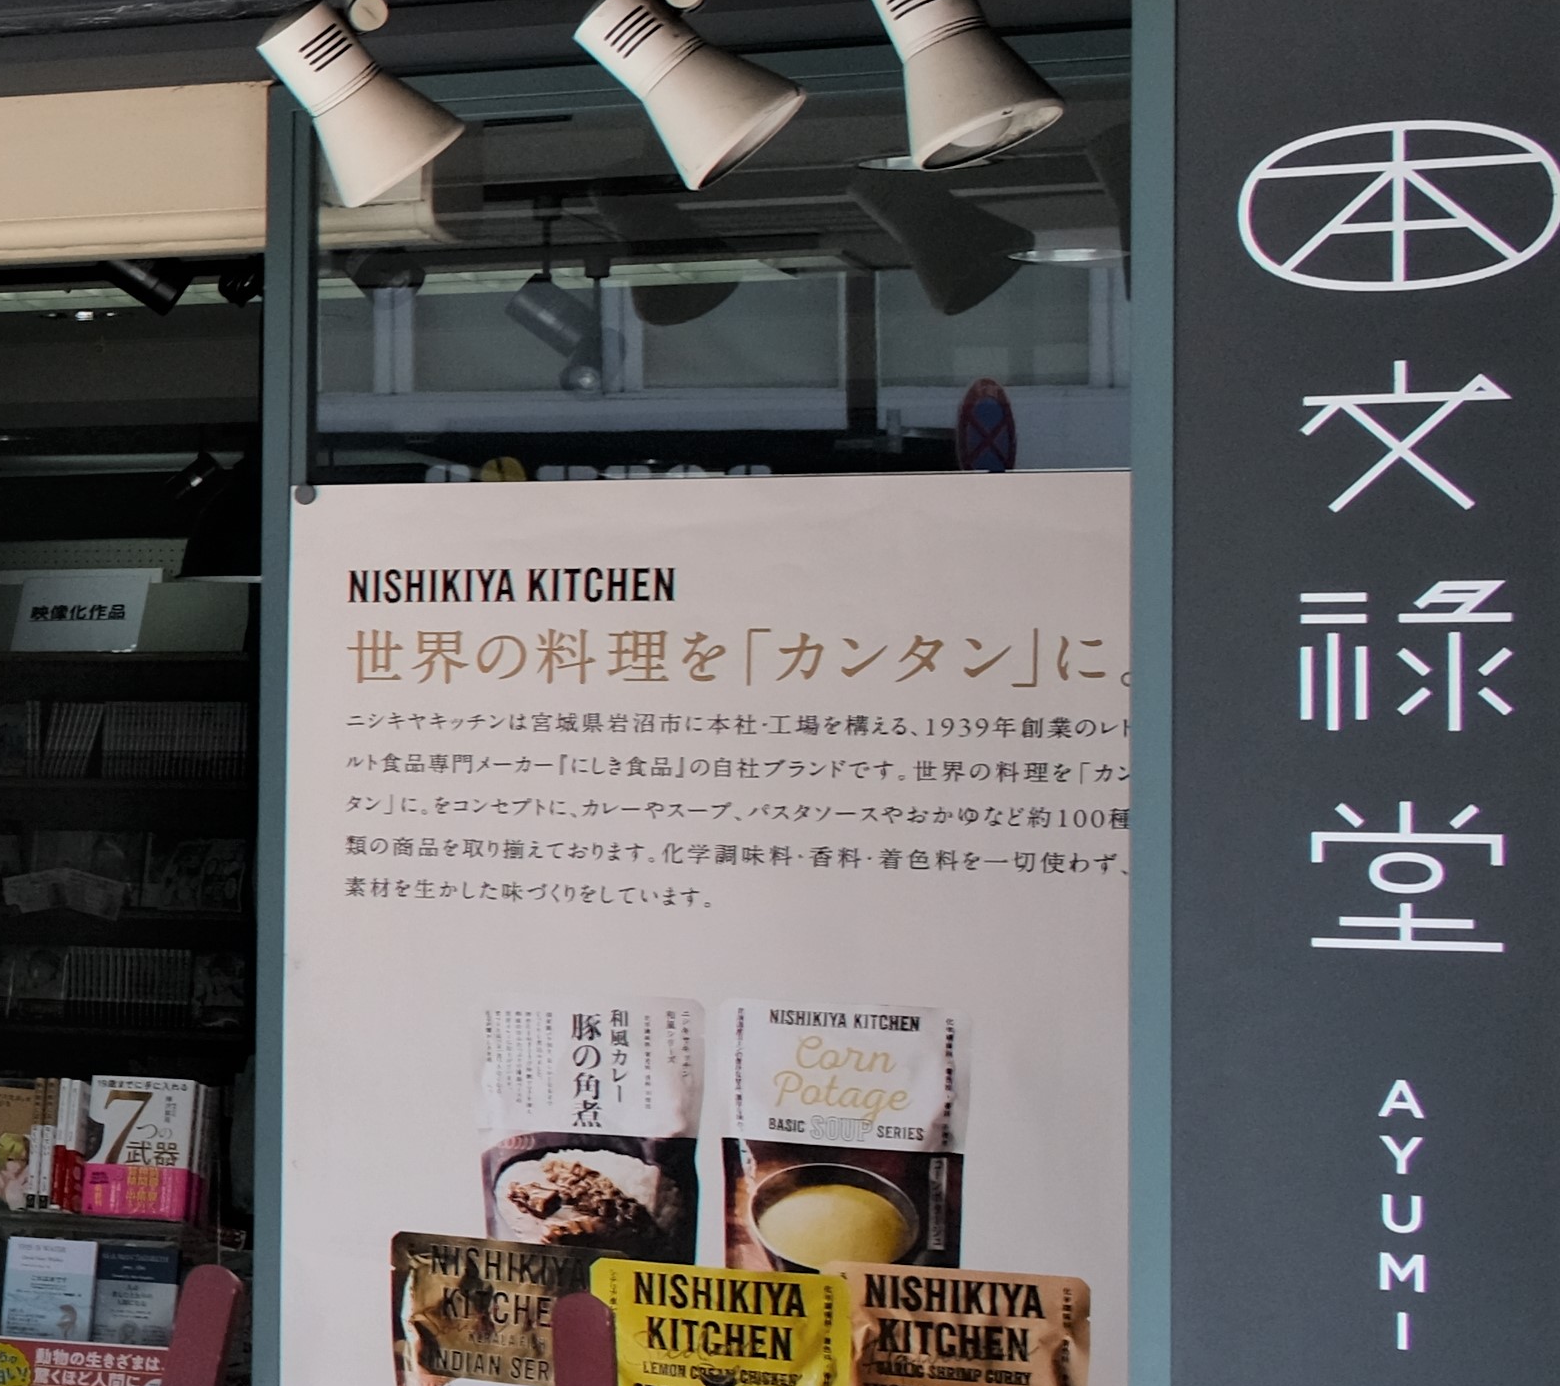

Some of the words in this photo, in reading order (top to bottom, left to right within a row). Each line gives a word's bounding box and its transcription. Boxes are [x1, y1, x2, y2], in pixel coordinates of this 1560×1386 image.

[347, 568, 515, 604] NISHIKIYA
[528, 566, 676, 603] KITCHEN
[30, 604, 126, 623] 映像化作品
[1301, 360, 1513, 952] 文禄堂
[345, 877, 712, 909] 素材を生かした味づくりをしています。
[770, 1009, 847, 1028] NISHIKIYA
[853, 1013, 920, 1032] KITCHEN
[571, 1012, 603, 1128] 豚の角煮
[610, 1009, 630, 1104] 和風カレー
[796, 1035, 897, 1074] Corn
[773, 1070, 913, 1124] Potage
[768, 1117, 805, 1133] BASIC
[809, 1115, 873, 1142] SOUP
[877, 1125, 925, 1141] SERIES
[126, 1141, 180, 1167] 武器
[1377, 1078, 1427, 1353] AYUMI
[430, 1244, 587, 1291] NISHIKIYA
[633, 1271, 807, 1318] NISHIKIYA
[864, 1273, 1047, 1319] NISHIKIYA
[646, 1315, 794, 1361] KITCHEN
[877, 1317, 1030, 1362] KITCHEN
[643, 1360, 686, 1379] LEMON
